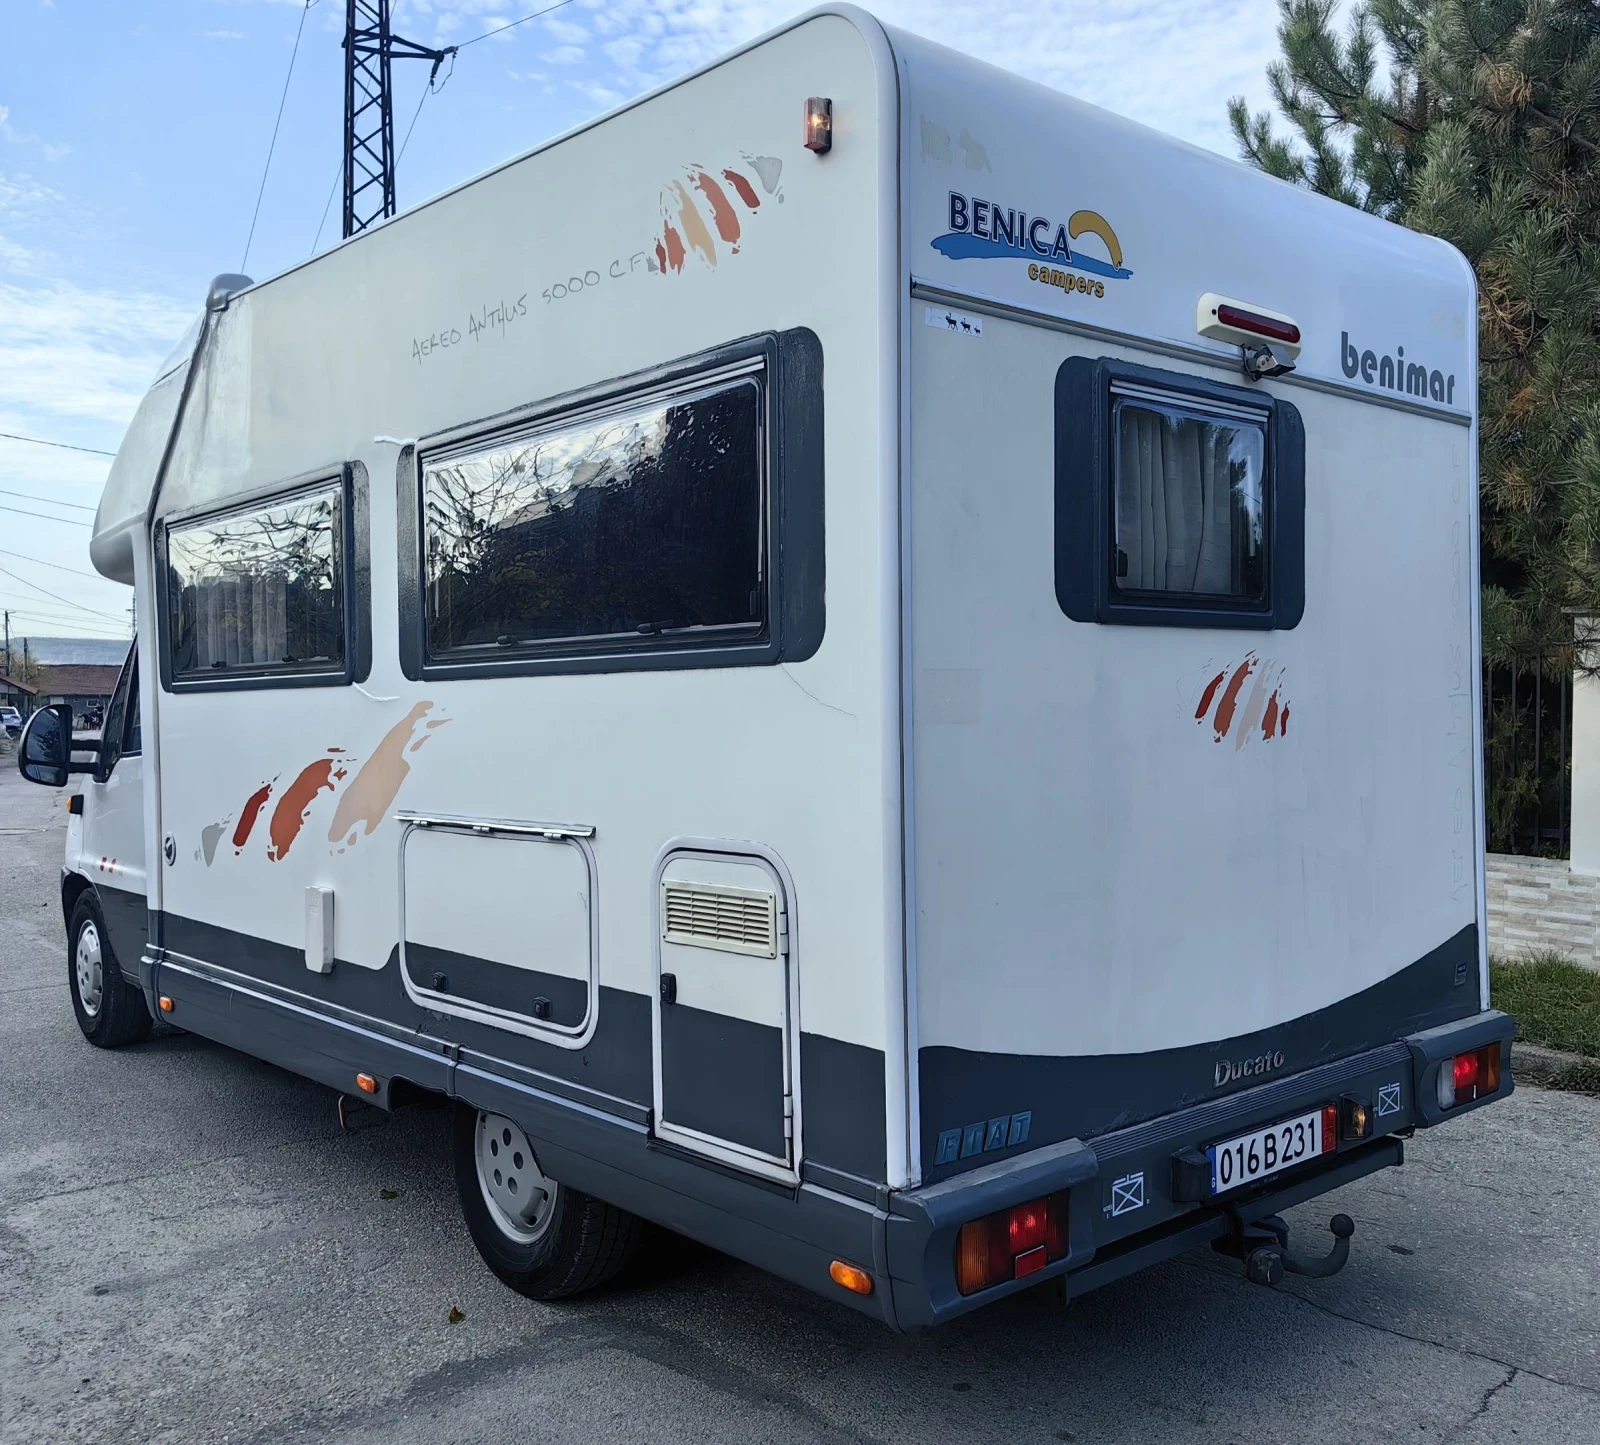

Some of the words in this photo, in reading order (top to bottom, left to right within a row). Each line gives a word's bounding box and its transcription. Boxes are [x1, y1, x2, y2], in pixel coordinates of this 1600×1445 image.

[948, 190, 1073, 263] BENICA
[468, 292, 528, 343] ANTHUS
[541, 270, 601, 305] 5000
[1027, 263, 1105, 299] campers
[1340, 330, 1455, 405] benimar
[1213, 1050, 1285, 1088] Ducato
[937, 1112, 1031, 1164] FIAT
[1220, 1117, 1315, 1185] 016B231
